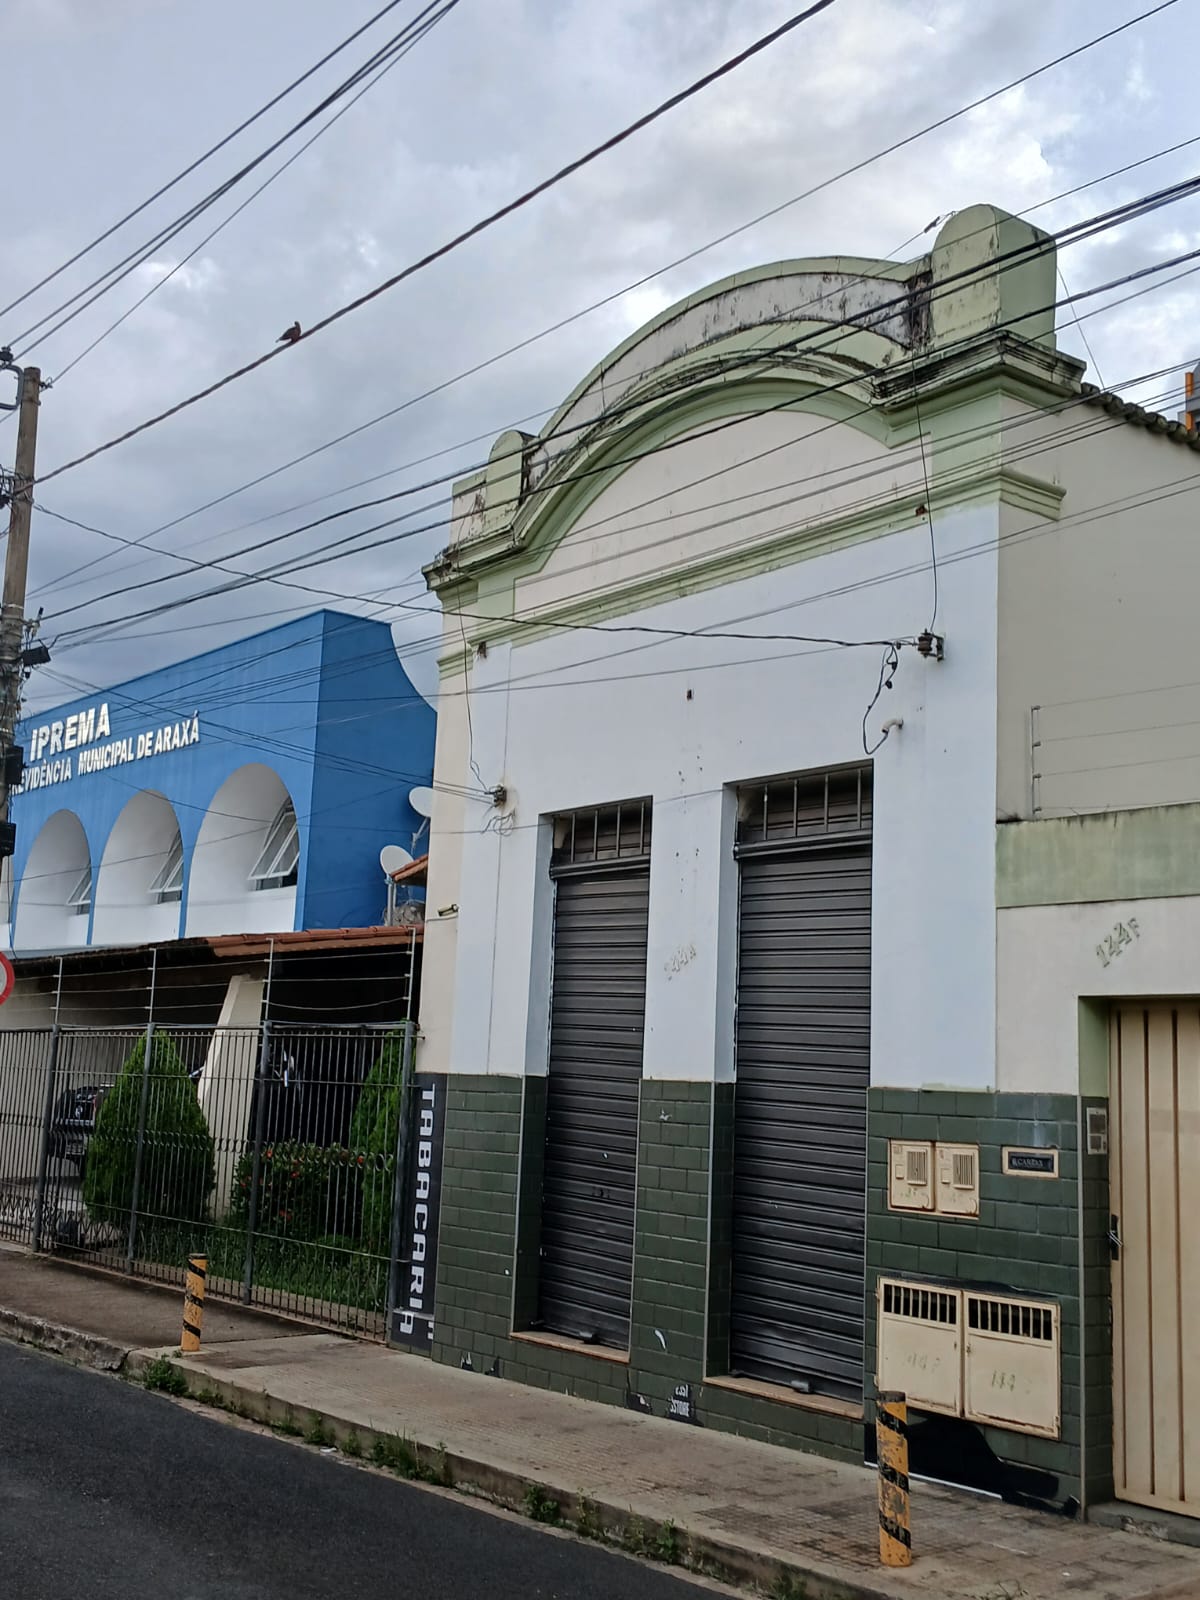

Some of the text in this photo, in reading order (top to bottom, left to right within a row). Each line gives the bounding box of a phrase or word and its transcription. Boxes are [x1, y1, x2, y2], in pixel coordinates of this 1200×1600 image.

[30, 703, 110, 762] IPREMA
[78, 736, 134, 776] MUNICIPAL
[136, 731, 152, 758] DE
[154, 710, 200, 756] ARAXÁ
